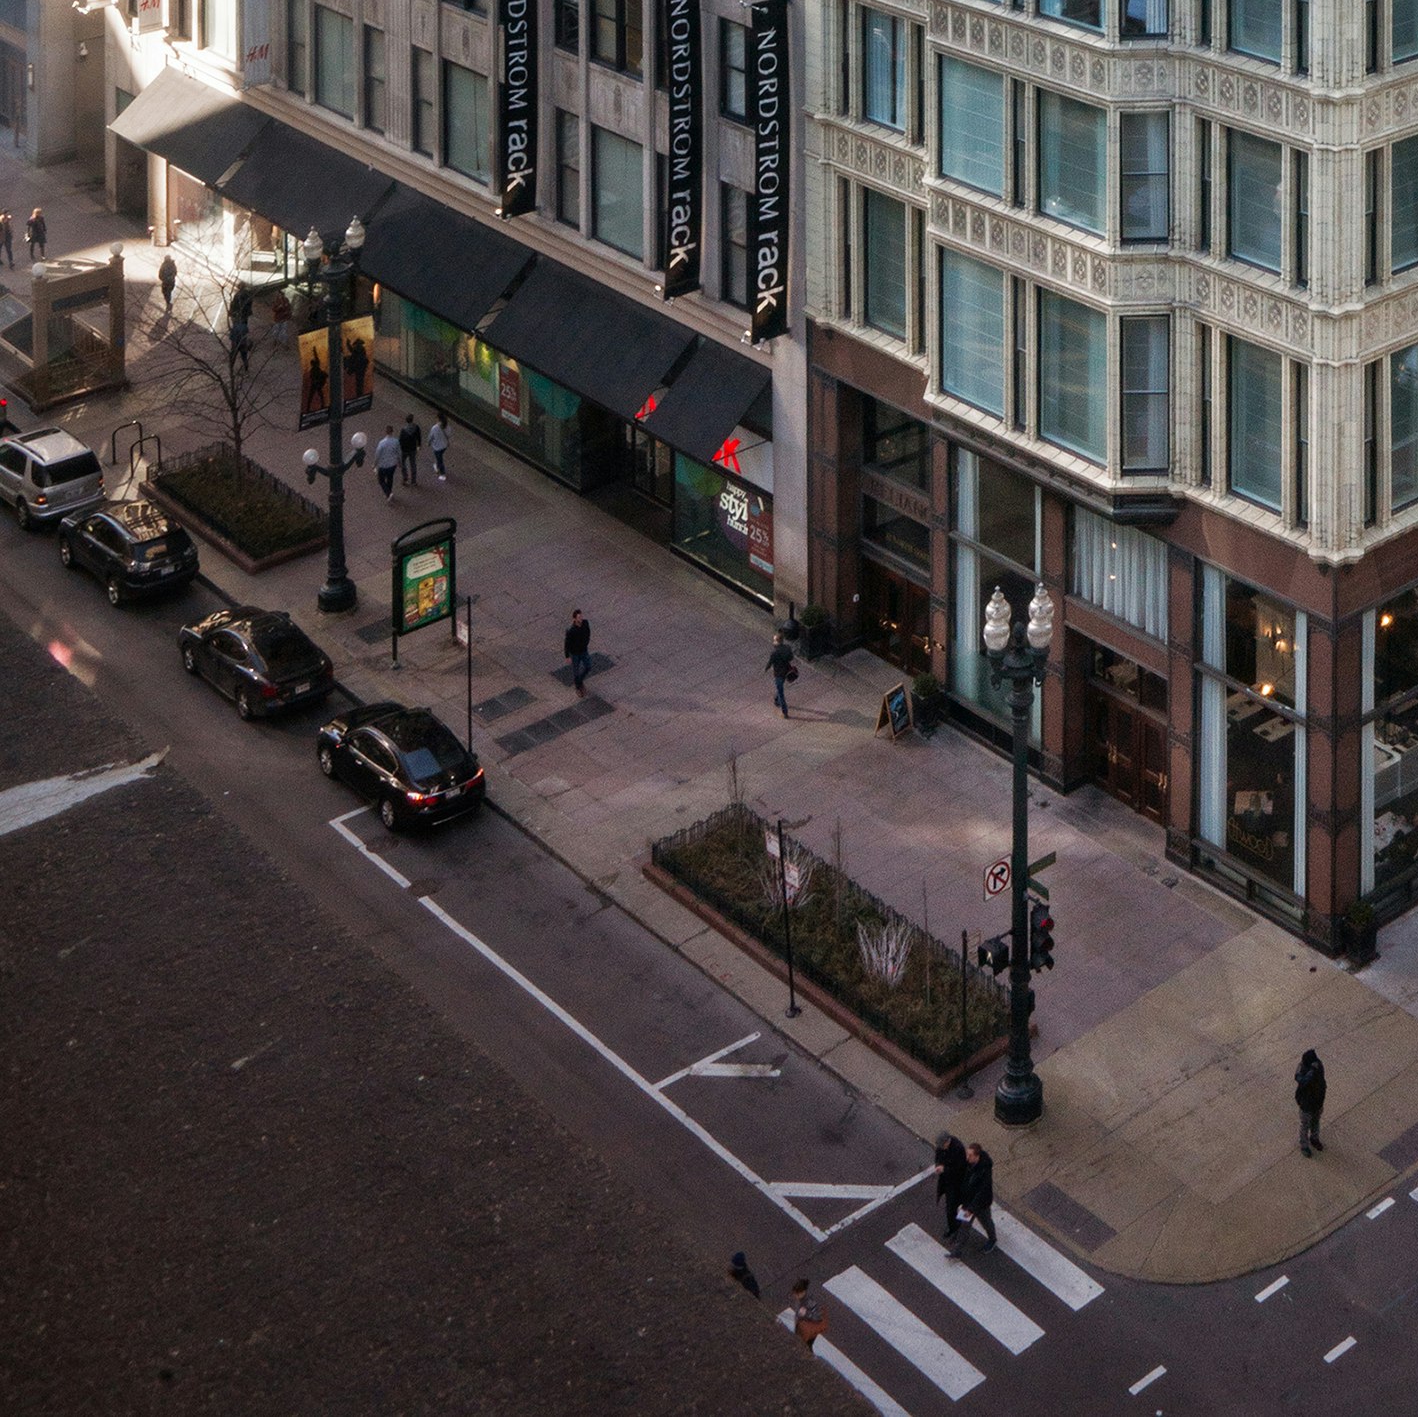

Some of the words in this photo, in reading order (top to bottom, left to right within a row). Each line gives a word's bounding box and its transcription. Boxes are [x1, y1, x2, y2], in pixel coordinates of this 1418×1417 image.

[507, 119, 533, 193] rack
[757, 26, 780, 223] NORDSTROM
[669, 190, 696, 269] rack
[757, 232, 785, 315] rack
